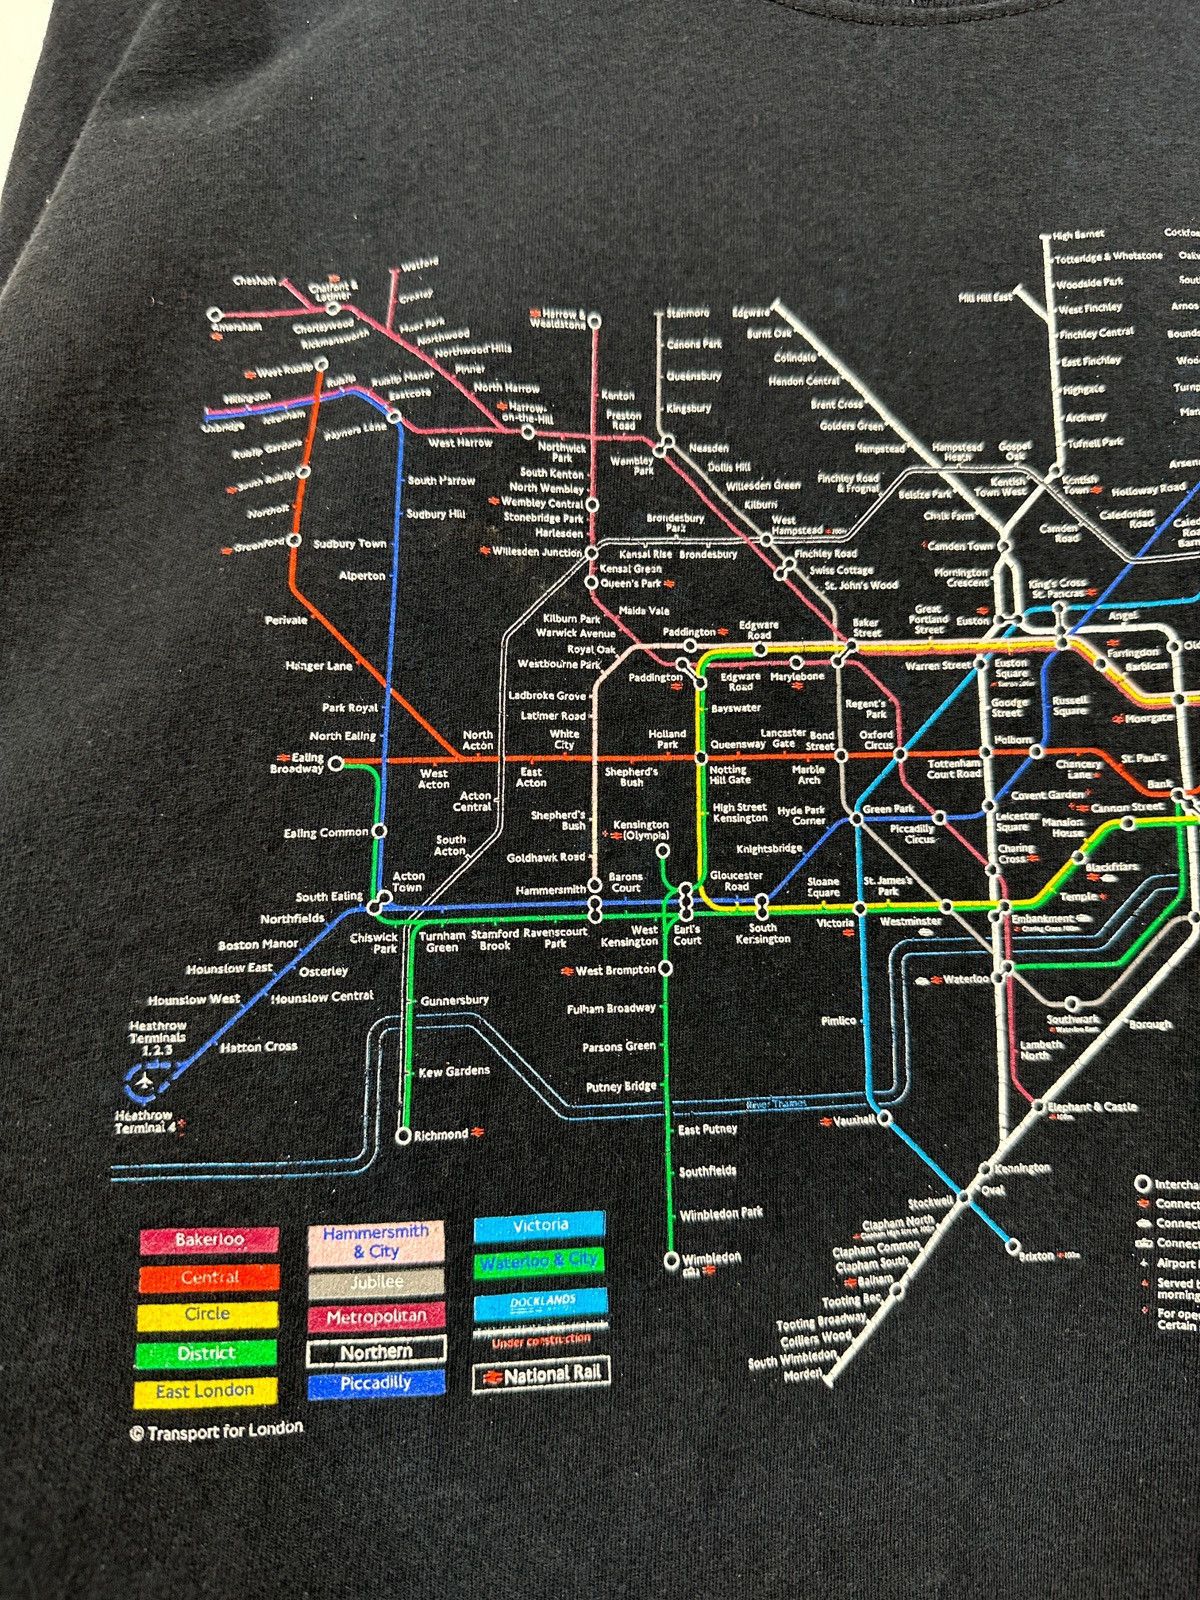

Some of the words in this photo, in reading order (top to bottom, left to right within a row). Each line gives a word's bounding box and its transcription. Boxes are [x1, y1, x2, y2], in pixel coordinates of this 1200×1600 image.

[501, 497, 544, 507] Wembley
[548, 499, 583, 508] Central
[407, 510, 446, 520] Sudbury
[449, 509, 465, 519] Hill
[504, 513, 560, 523] Stonebridge
[563, 515, 583, 523] Park
[314, 540, 355, 550] Sudbury
[358, 540, 387, 548] Town
[928, 542, 964, 550] Camden
[967, 542, 993, 550] Town
[492, 547, 541, 556] Willesden
[544, 549, 582, 557] Junction
[339, 571, 385, 581] Alperton
[601, 579, 638, 588] Queen's
[641, 579, 661, 587] Park
[840, 581, 869, 591] John's
[872, 580, 898, 590] Wood
[619, 606, 646, 616] Maida
[649, 606, 669, 616] Vale
[544, 614, 576, 623] Kilburn
[580, 615, 600, 624] Park
[853, 618, 878, 627] Baker
[739, 621, 778, 631] Edgware
[536, 629, 577, 638] Warwick
[580, 629, 616, 638] Avenue
[663, 627, 716, 637] Paddington
[748, 631, 771, 640] Road
[854, 628, 882, 637] Street
[567, 645, 593, 655] Royal
[597, 645, 616, 654] Oak
[518, 660, 577, 669] Westbourne
[579, 660, 600, 670] Park
[629, 673, 683, 683] Paddington
[721, 672, 761, 682] Edgware
[771, 672, 825, 681] Marylebone
[729, 682, 753, 691] Road
[509, 692, 554, 700] Ladbroke
[557, 692, 586, 700] Grove
[711, 704, 761, 714] Bayswater
[521, 712, 556, 721] Latimer
[559, 712, 586, 721] Road
[310, 732, 341, 740] North
[345, 732, 376, 742] Ealing
[550, 730, 579, 738] White
[649, 730, 686, 738] Holland
[860, 731, 893, 740] Oxford
[555, 740, 575, 750] City
[657, 740, 678, 749] Park
[710, 740, 766, 750] Queensway
[865, 740, 893, 749] Circus
[292, 753, 324, 763] Ealing
[928, 759, 981, 768] Tottenham
[271, 765, 324, 775] Broadway
[420, 769, 448, 778] West
[521, 767, 542, 777] East
[605, 767, 658, 777] Shepherd's
[710, 766, 747, 775] Notting
[927, 770, 954, 779] Court
[957, 769, 982, 778] Road
[419, 780, 450, 789] Acton
[516, 778, 546, 787] Acton
[620, 778, 643, 787] Bush
[710, 775, 725, 784] Hill
[728, 775, 751, 784] Gate
[713, 803, 735, 812] High
[738, 803, 767, 812] Street
[863, 805, 893, 813] Green
[895, 805, 915, 813] Park
[714, 813, 768, 823] Kensington
[613, 820, 669, 831] Kensington
[284, 829, 317, 839] Ealing
[320, 828, 369, 837] Common
[623, 830, 669, 840] (Olympia)
[737, 844, 802, 853] Knightsbridge
[507, 853, 558, 862] Goldhawk
[560, 853, 585, 861] Road
[393, 872, 425, 881] Acton
[710, 871, 763, 880] Gloucester
[392, 883, 422, 892] Town
[516, 886, 586, 895] Hammersmith
[725, 882, 749, 891] Road
[296, 892, 328, 902] South
[332, 892, 363, 902] Ealing
[260, 914, 325, 924] Northfields
[817, 919, 854, 928] Victoria
[880, 917, 942, 927] Westminster
[471, 930, 519, 939] Stamford
[523, 927, 587, 938] Ravenscourt
[631, 926, 658, 934] West
[674, 925, 700, 934] Earl's
[419, 931, 466, 940] Turnham
[674, 936, 702, 945] Court
[218, 941, 259, 950] Boston
[262, 940, 298, 949] Manor
[480, 941, 510, 950] Brook
[545, 939, 566, 948] Park
[601, 937, 658, 947] Kensington
[427, 943, 458, 952] Green
[300, 967, 348, 977] Osterley
[576, 966, 603, 975] West
[606, 965, 656, 975] Brompton
[943, 974, 989, 984] Waterloo
[421, 996, 489, 1006] Gunnersbury
[568, 1005, 604, 1014] Fulham
[607, 1004, 656, 1014] Broadway
[821, 1016, 856, 1026] Pimlico
[1129, 1020, 1172, 1031] Borough
[583, 1043, 622, 1052] Parsons
[626, 1042, 656, 1050] Green
[419, 1068, 443, 1077] Kew
[446, 1066, 490, 1076] Gardens
[586, 1082, 622, 1093] Putney
[625, 1081, 657, 1091] Bridge
[834, 1115, 876, 1125] Vauxhall
[678, 1125, 700, 1135] East
[703, 1124, 737, 1135] Putney
[415, 1129, 468, 1141] Richmond
[679, 1164, 736, 1177] Southfields
[680, 1209, 741, 1222] Wimbledon
[744, 1206, 762, 1217] Park
[513, 1217, 569, 1231] Victoria
[323, 1224, 429, 1240] Hammersmith
[175, 1233, 245, 1246] Bakerloo
[354, 1246, 364, 1258] &
[369, 1244, 399, 1260] City
[480, 1255, 549, 1269] Waterloo
[554, 1255, 565, 1268] &
[570, 1253, 597, 1268] City
[181, 1270, 239, 1284] Central
[350, 1275, 403, 1289] Jubilee
[510, 1294, 575, 1307] DOCKLANDS
[185, 1307, 230, 1320] Circle
[327, 1309, 427, 1325] Metropolitan
[492, 1337, 524, 1349] Under
[527, 1332, 591, 1346] construction
[178, 1346, 236, 1360] District
[340, 1344, 413, 1359] Northern
[504, 1367, 570, 1383] National
[574, 1365, 601, 1379] Rail
[341, 1375, 411, 1393] Piccadilly
[156, 1383, 190, 1399] East
[194, 1382, 254, 1398] London
[148, 1424, 218, 1443] Transport
[223, 1423, 244, 1437] for
[249, 1419, 304, 1437] London
